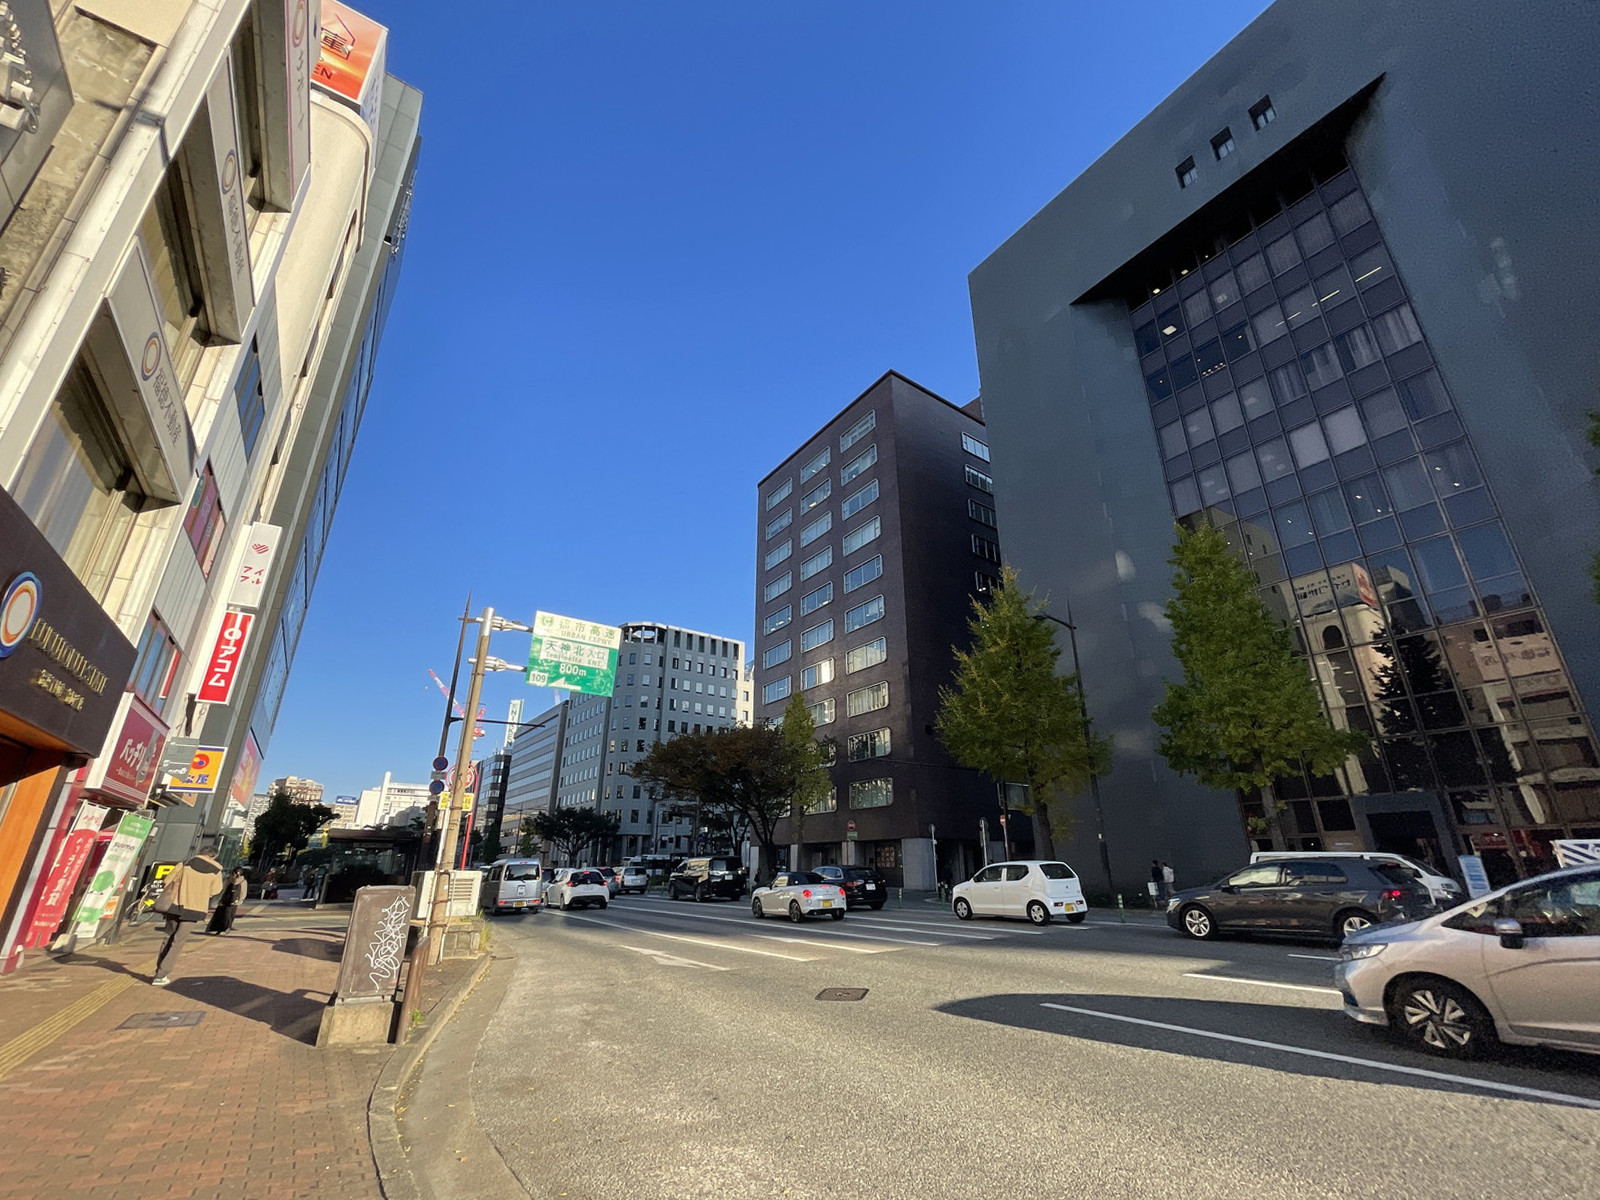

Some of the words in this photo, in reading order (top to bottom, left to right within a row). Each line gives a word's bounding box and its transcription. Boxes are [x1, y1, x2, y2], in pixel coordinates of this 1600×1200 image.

[561, 630, 586, 641] URBAN
[545, 640, 606, 660] 天神北入口
[207, 645, 237, 687] アコム
[531, 673, 547, 683] 109
[154, 864, 176, 880] P
